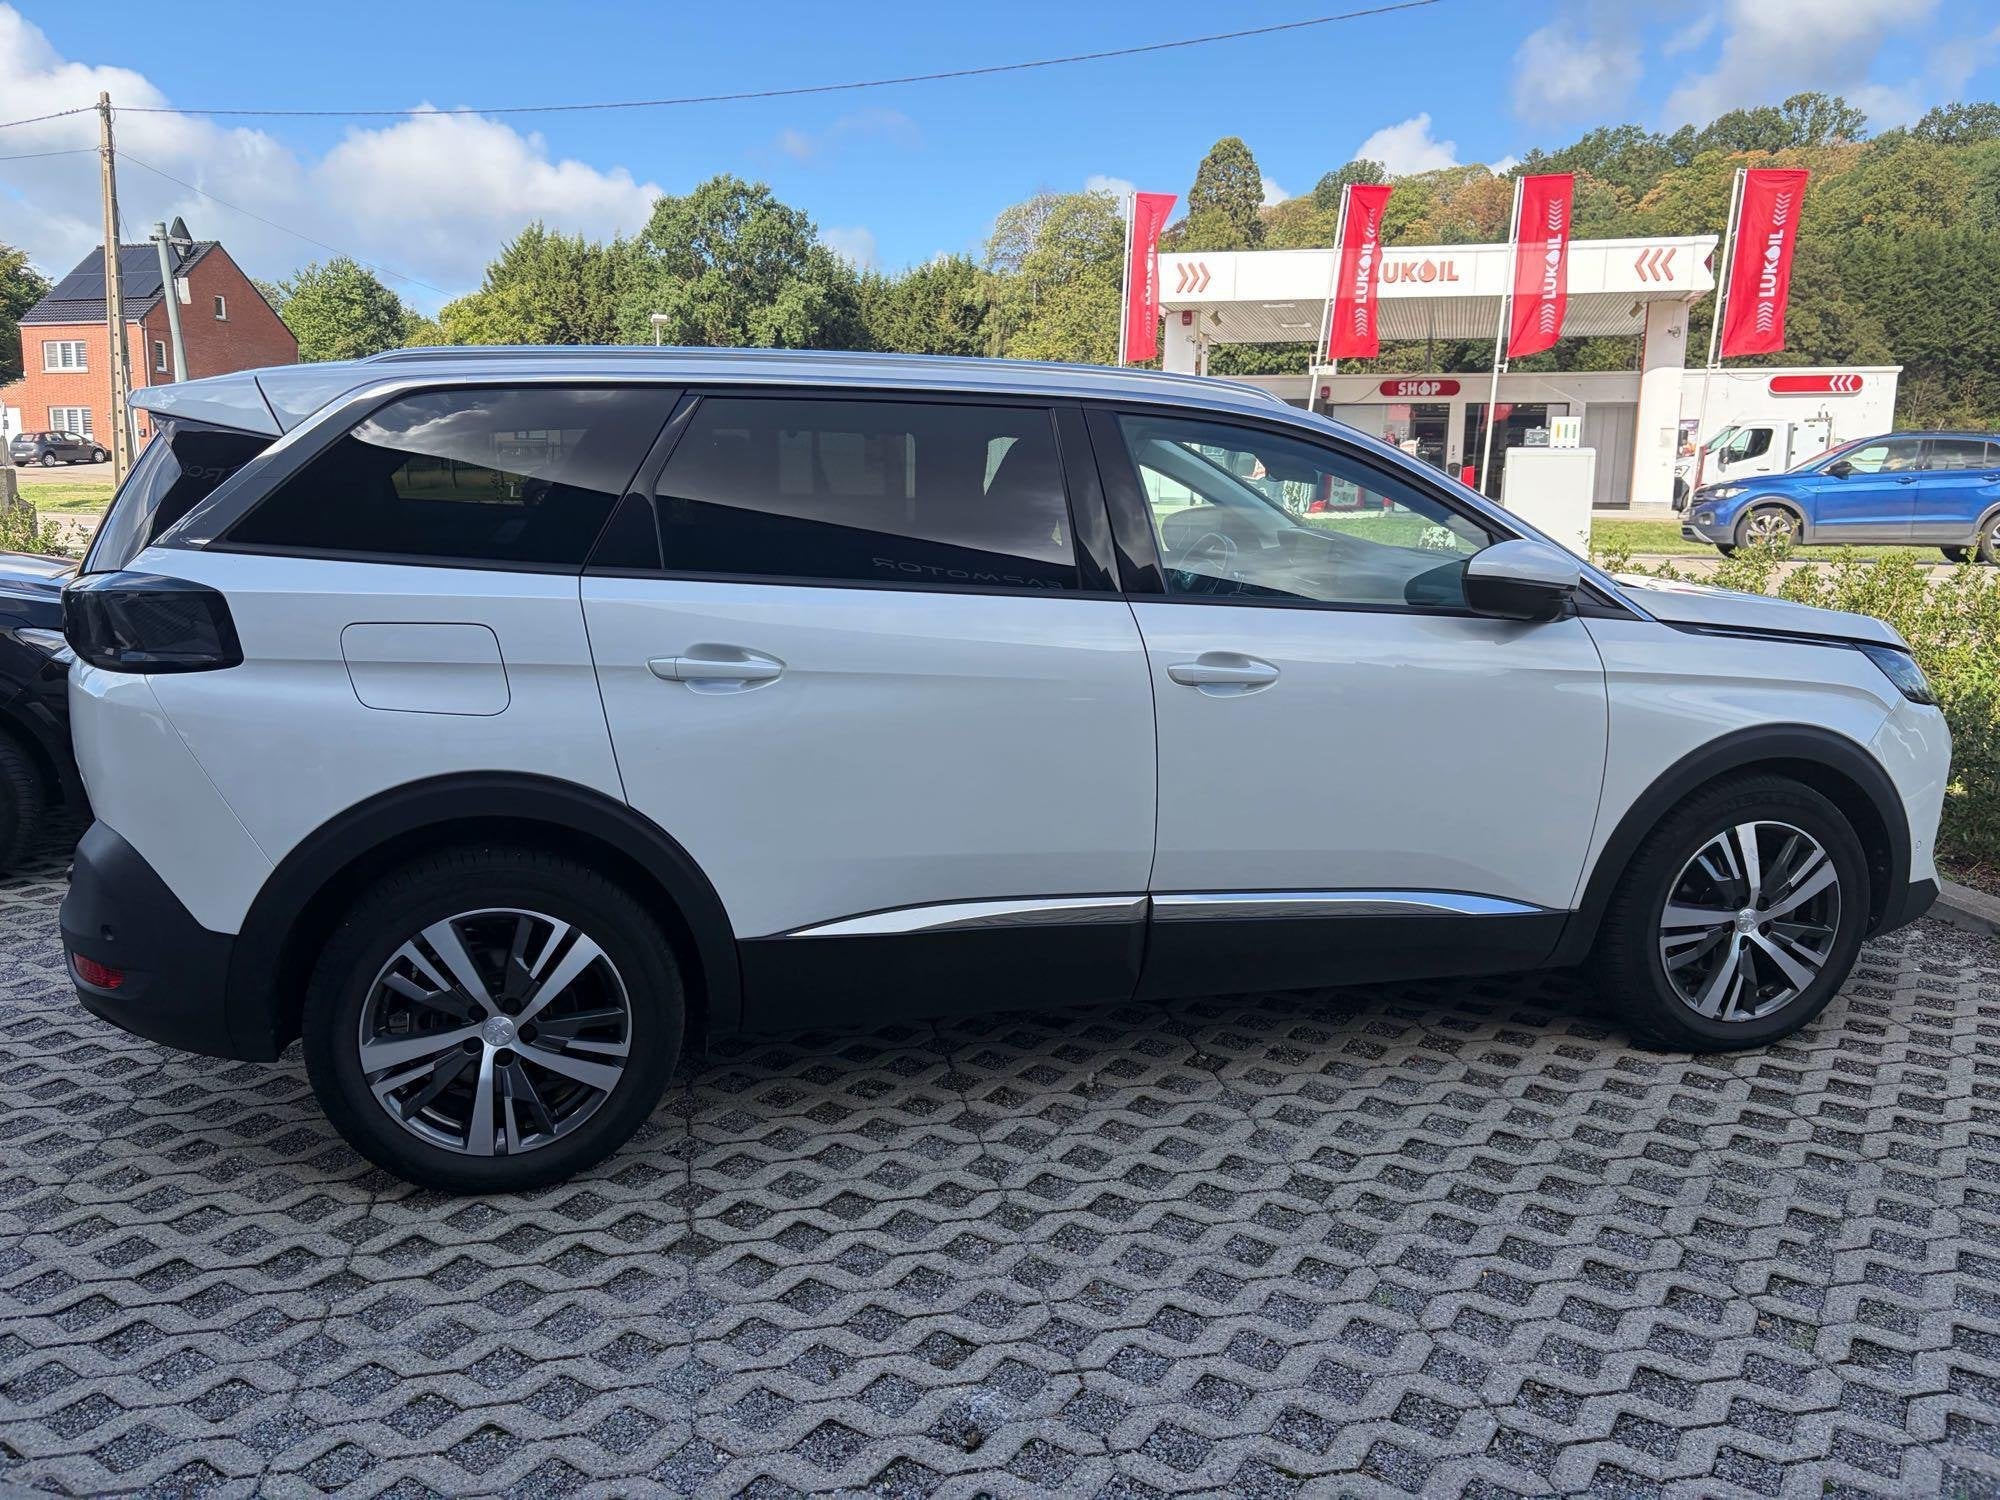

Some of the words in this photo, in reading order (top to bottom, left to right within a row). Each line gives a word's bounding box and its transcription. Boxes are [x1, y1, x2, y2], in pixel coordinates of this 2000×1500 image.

[1354, 241, 1376, 304] LUKOIL
[1377, 259, 1459, 283] UKOIL
[1542, 234, 1562, 300] LUKOIL
[1757, 229, 1784, 298] LUKOIL
[1397, 381, 1442, 396] SHOP
